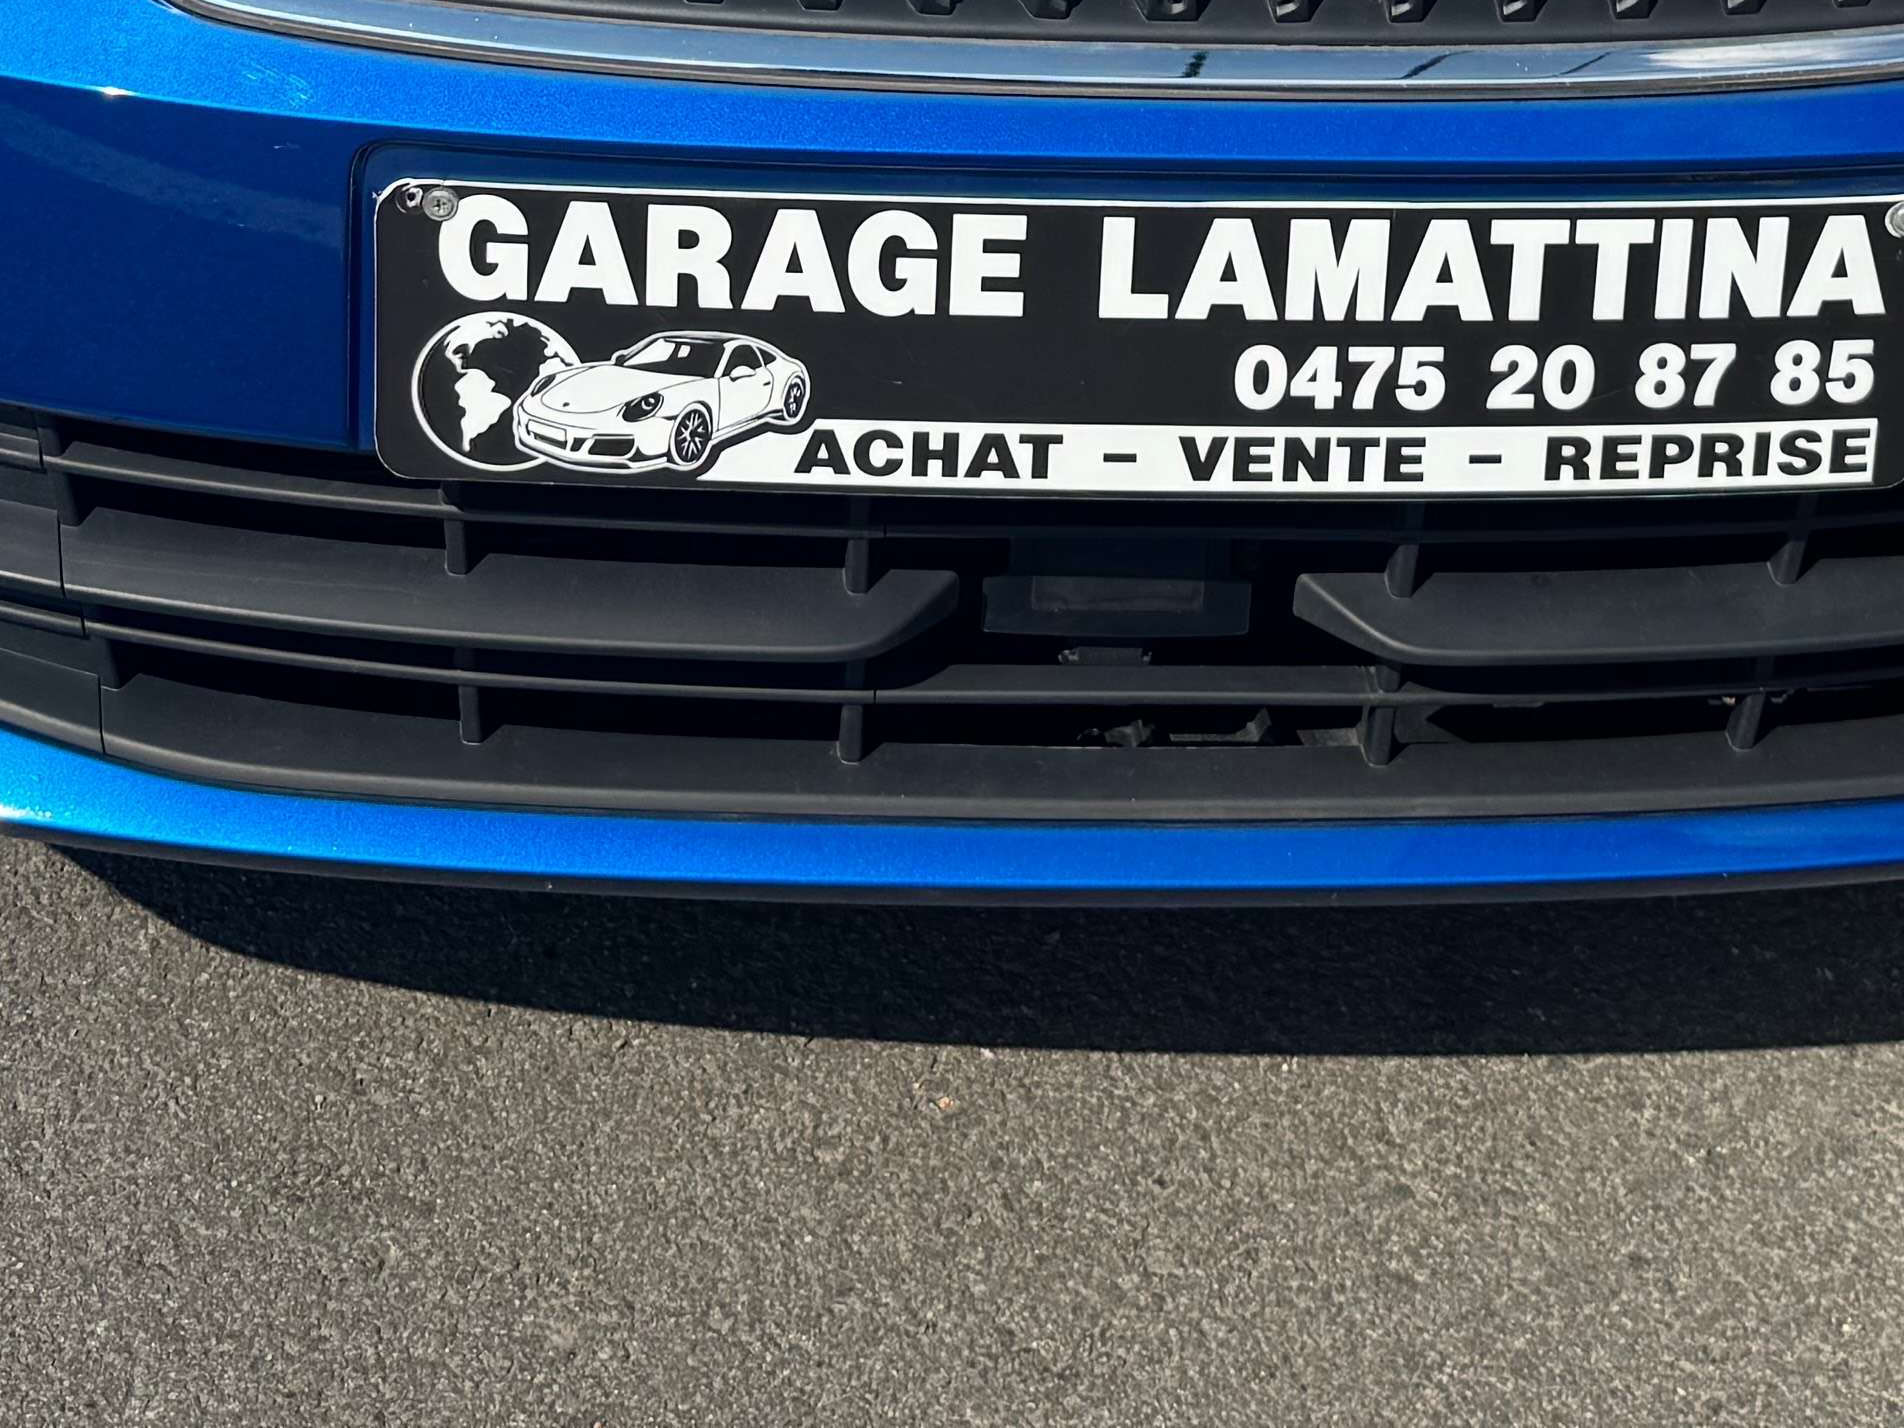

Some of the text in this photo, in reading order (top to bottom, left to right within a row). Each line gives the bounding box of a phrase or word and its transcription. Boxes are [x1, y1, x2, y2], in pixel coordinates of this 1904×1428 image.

[437, 200, 1886, 322] GARAGE LAMATTINA
[1233, 335, 1875, 413] 0475 20 87 85
[792, 428, 1065, 484] ACHAT
[1179, 431, 1426, 484] VENTE
[1542, 427, 1872, 483] REPRISE
